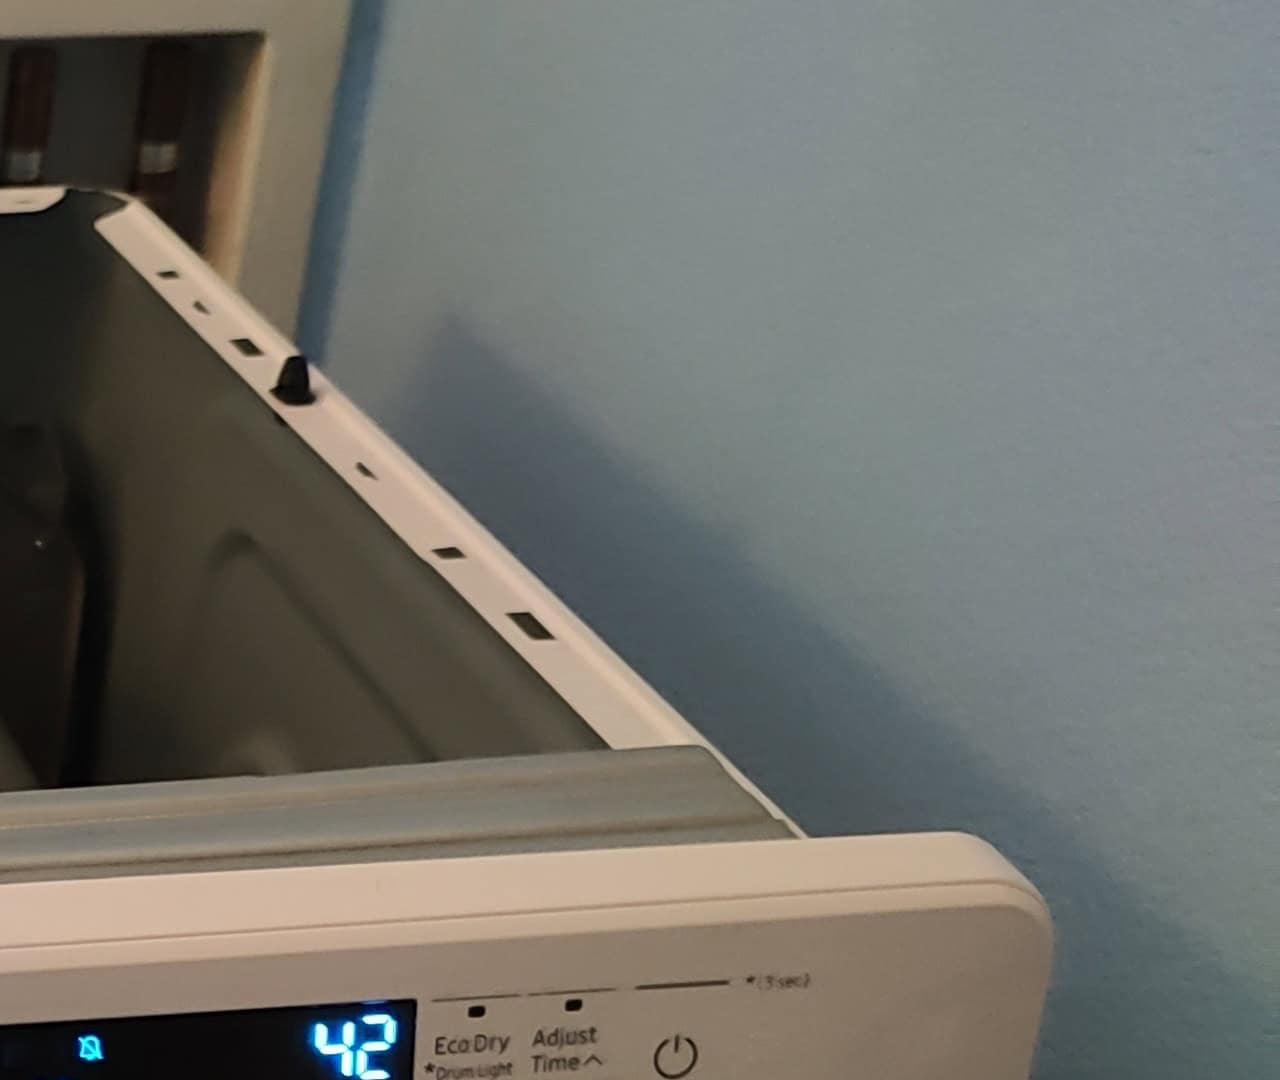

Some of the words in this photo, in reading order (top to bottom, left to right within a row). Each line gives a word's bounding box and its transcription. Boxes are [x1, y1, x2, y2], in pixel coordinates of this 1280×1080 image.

[314, 1014, 398, 1080] 42
[434, 1036, 470, 1055] Eco
[473, 1034, 511, 1054] Dry
[532, 1026, 597, 1048] Adjust
[531, 1054, 581, 1073] Time
